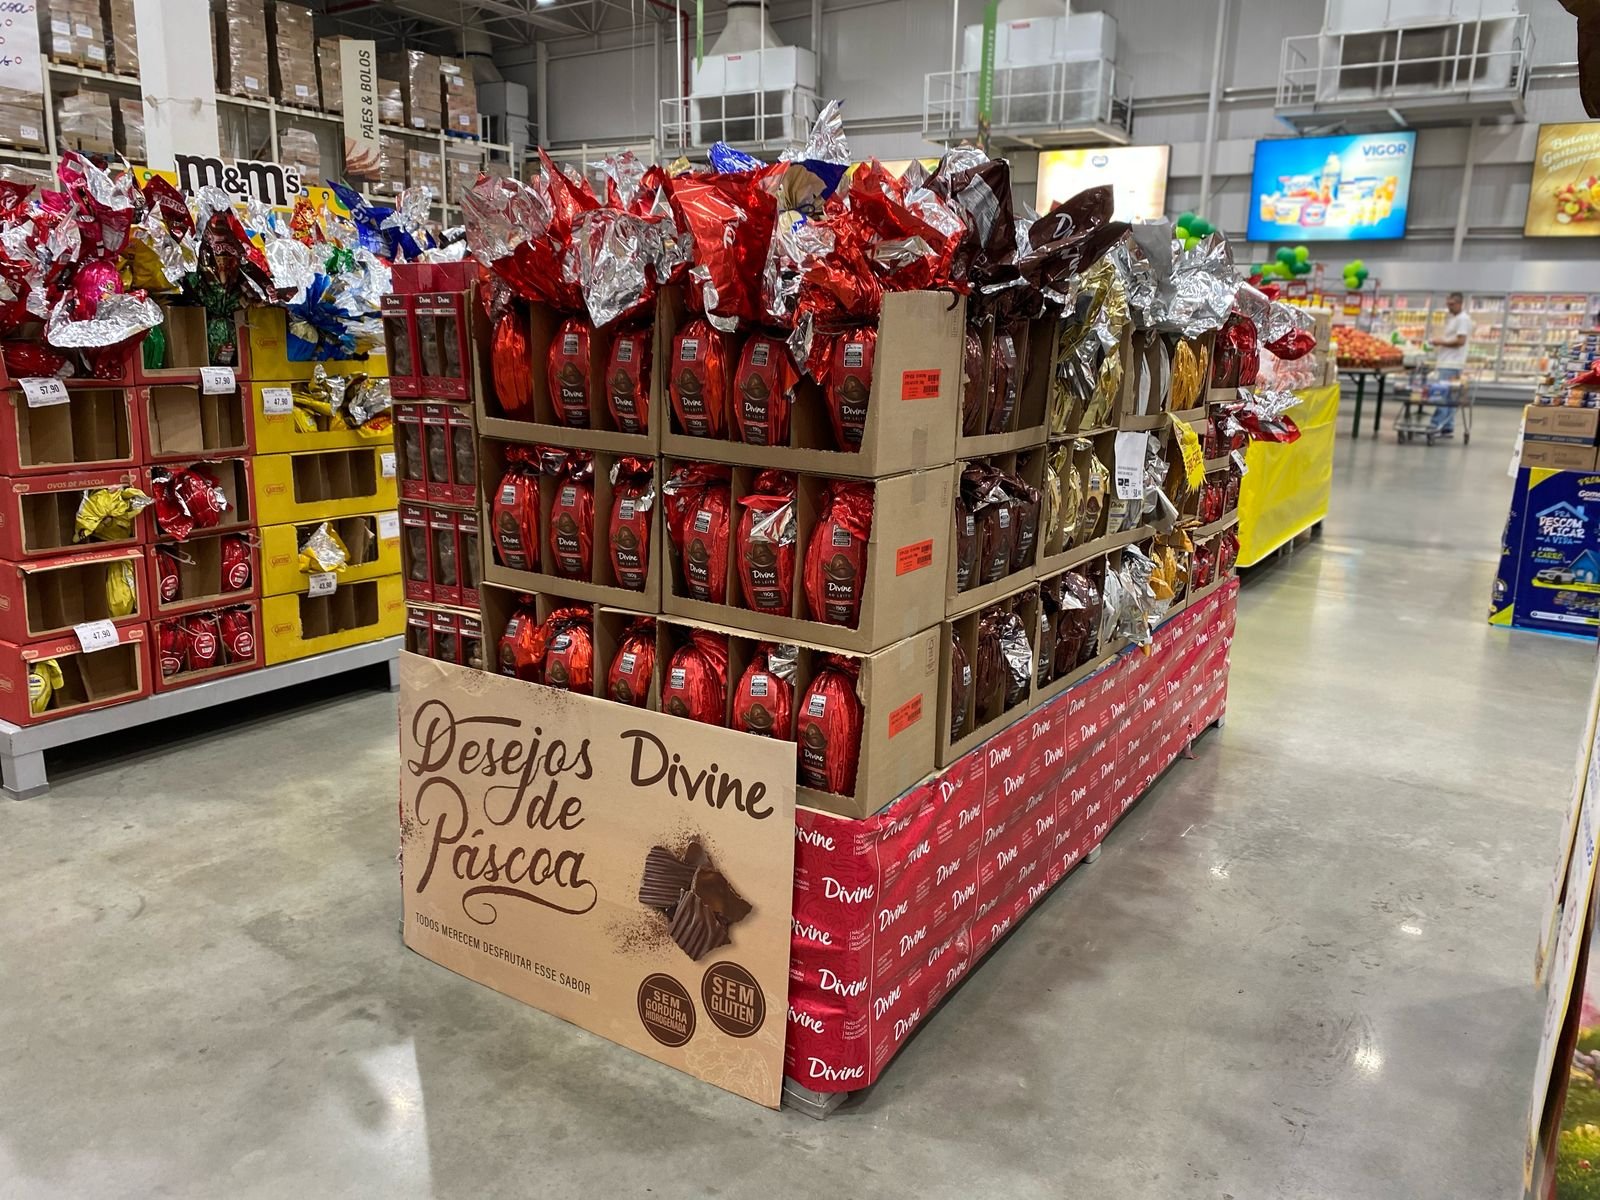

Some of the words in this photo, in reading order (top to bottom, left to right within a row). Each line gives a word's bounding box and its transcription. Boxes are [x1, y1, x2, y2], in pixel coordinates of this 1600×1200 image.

[358, 49, 372, 92] BOLOS
[361, 95, 373, 106] &
[360, 108, 374, 140] PÃES
[1362, 143, 1406, 156] VIGOR
[682, 397, 702, 406] Divine
[745, 402, 766, 414] Divine
[842, 406, 866, 415] Divine
[47, 482, 67, 490] OVOS
[1538, 516, 1583, 528] DESCOM
[1543, 526, 1585, 538] PLICAR
[501, 535, 519, 544] Divine
[557, 537, 577, 547] Divine
[1552, 536, 1573, 544] VIDA
[617, 552, 638, 562] Divine
[1537, 551, 1563, 560] CARRO
[689, 563, 707, 575] Divine
[752, 570, 775, 579] Divine
[828, 583, 852, 592] Divine
[1069, 697, 1086, 716] Divine
[1111, 701, 1126, 720] Divine
[1032, 719, 1051, 740] Divine
[1081, 722, 1097, 742] Divine
[408, 699, 593, 826] Desejos
[804, 749, 824, 762] Divine
[989, 746, 1012, 768] Divine
[1044, 746, 1065, 767] Divine
[620, 729, 774, 820] Divine
[1101, 760, 1115, 779] Divine
[1003, 773, 1025, 796] Divine
[1071, 785, 1086, 805] Divine
[526, 779, 586, 830] de
[1086, 800, 1101, 820] Divine
[959, 803, 981, 830] Divine
[1036, 813, 1055, 836] Divine
[794, 826, 835, 851] ivine
[985, 822, 1006, 846] Divine
[415, 777, 598, 925] Páscoa
[997, 846, 1019, 870] Divine
[1063, 849, 1079, 870] Divine
[936, 858, 960, 886] Divine
[822, 877, 875, 904] Divine
[952, 883, 976, 911] Divine
[1028, 880, 1045, 904] Divine
[879, 900, 908, 933] Divine
[791, 915, 832, 945] ivine
[991, 917, 1010, 942] Divine
[415, 911, 440, 933] TODOS
[441, 924, 480, 950] MERECEM
[483, 941, 532, 972] DESFRUTAR
[534, 963, 557, 981] ESSE
[559, 973, 591, 995] SABOR
[900, 926, 927, 957] Divine
[818, 968, 868, 997] Divine
[946, 959, 968, 988] Divine
[653, 990, 681, 1010] SEM
[712, 976, 755, 1007] SEM
[873, 985, 902, 1021] Divine
[645, 998, 688, 1025] GORDURA
[711, 994, 755, 1025] GLUTEN
[788, 1006, 825, 1034] ivine
[645, 1009, 687, 1034] HIDROGENADA
[893, 1007, 921, 1041] Divine
[808, 1056, 865, 1081] Divine
